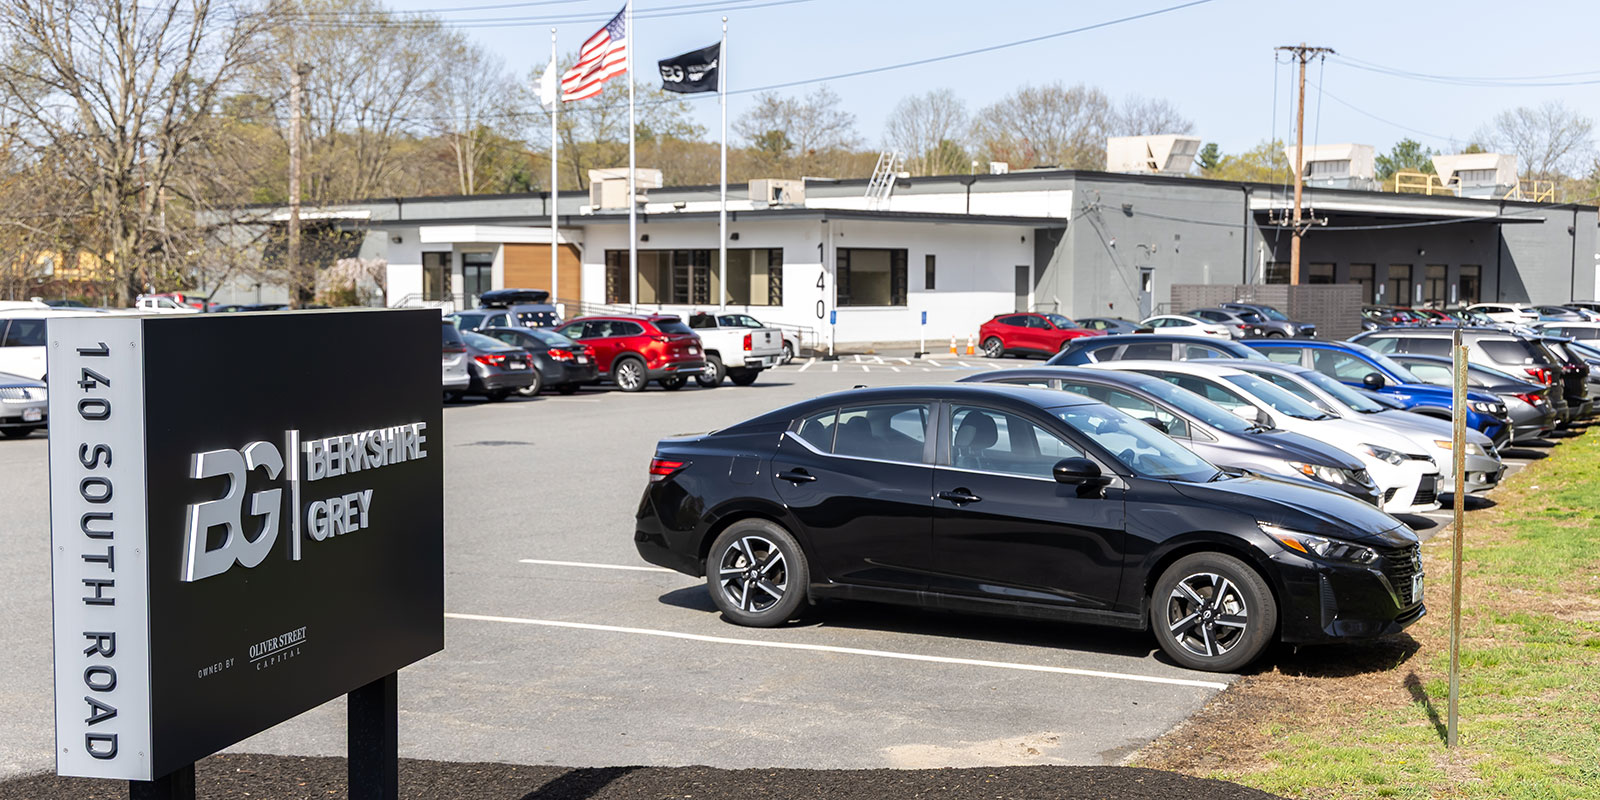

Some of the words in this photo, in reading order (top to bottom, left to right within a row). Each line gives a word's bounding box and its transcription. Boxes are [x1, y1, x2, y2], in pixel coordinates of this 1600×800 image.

[816, 242, 825, 320] 140
[76, 342, 111, 421] 140
[303, 421, 427, 481] BERKSHIRE
[78, 442, 115, 606] SOUTH
[181, 441, 284, 582] BG
[306, 489, 373, 541] GREY
[198, 662, 223, 678] OWNED
[225, 657, 235, 669] BY
[249, 637, 278, 658] OLIVER
[279, 626, 306, 647] STREET
[256, 647, 301, 670] CAPITAL
[83, 631, 118, 760] ROAD
